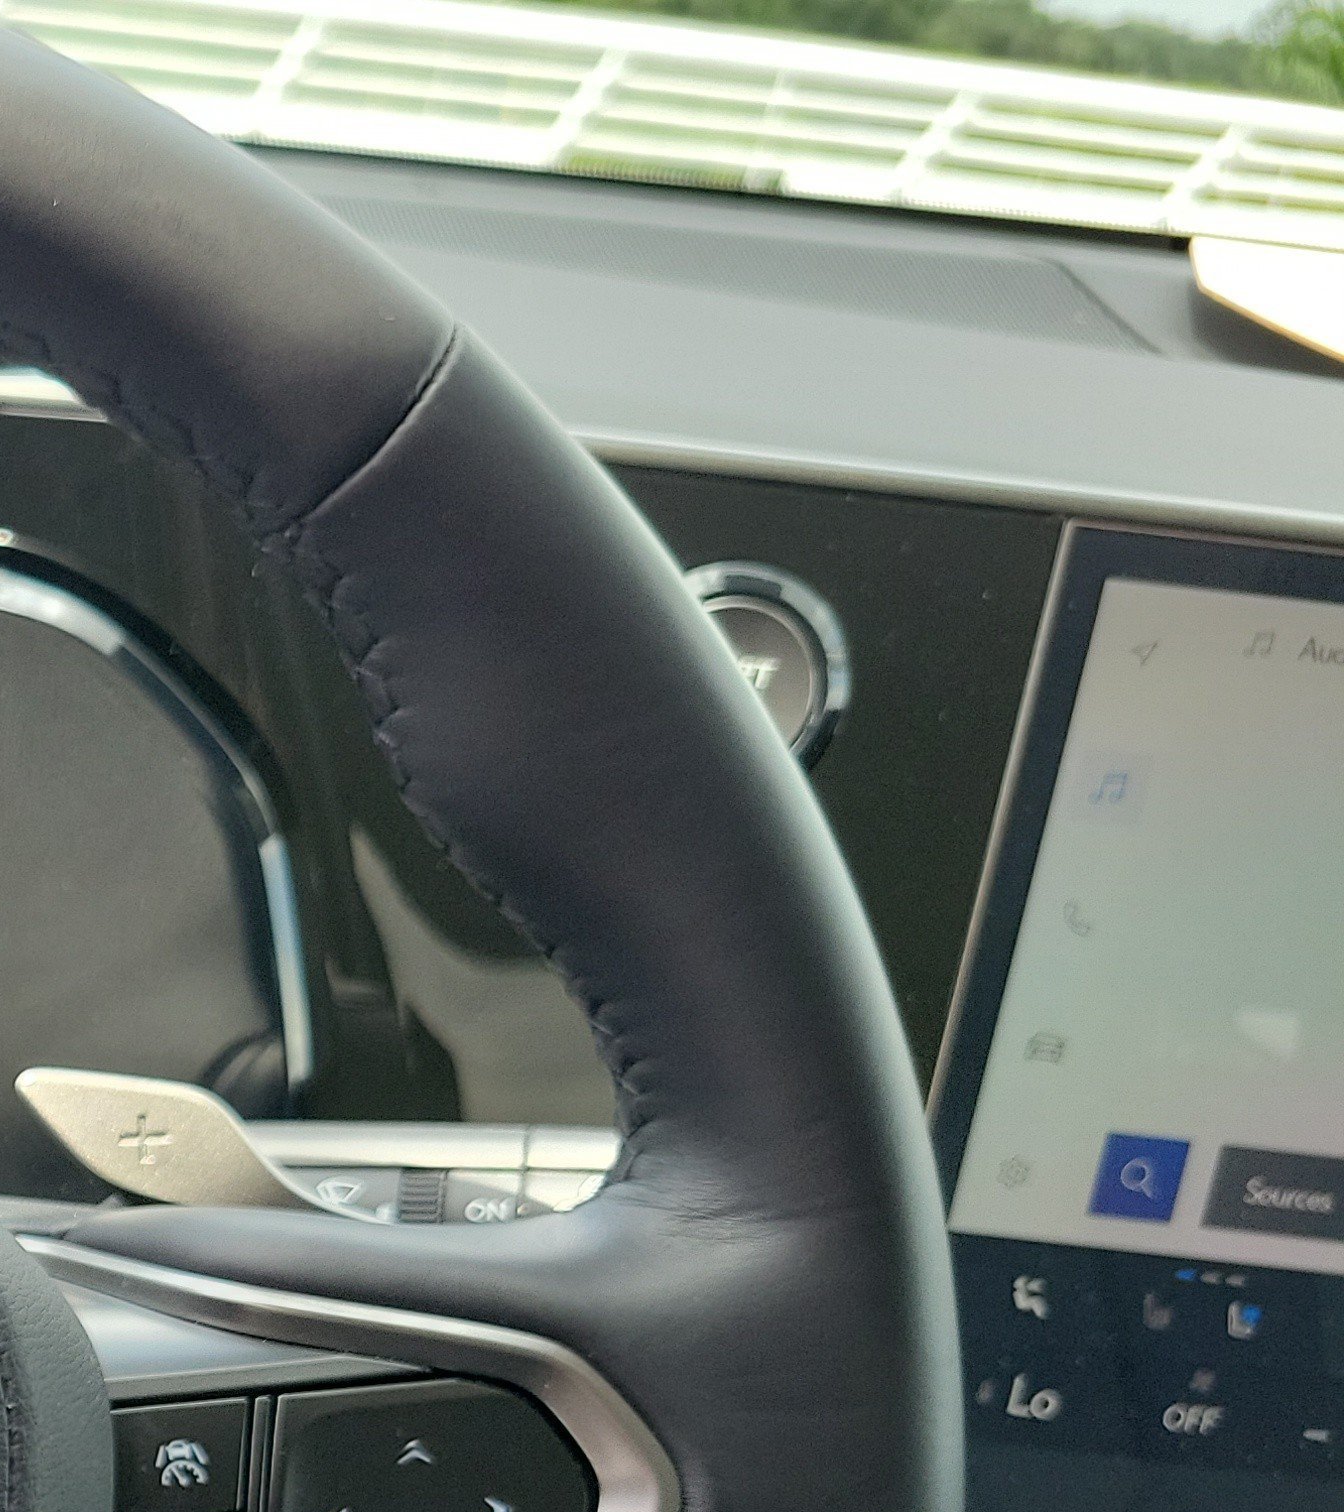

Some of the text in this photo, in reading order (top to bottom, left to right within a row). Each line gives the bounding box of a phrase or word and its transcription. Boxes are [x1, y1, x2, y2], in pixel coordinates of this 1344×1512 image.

[463, 1199, 518, 1223] ON
[1242, 1176, 1334, 1213] Sources
[1162, 1402, 1225, 1436] OFF
